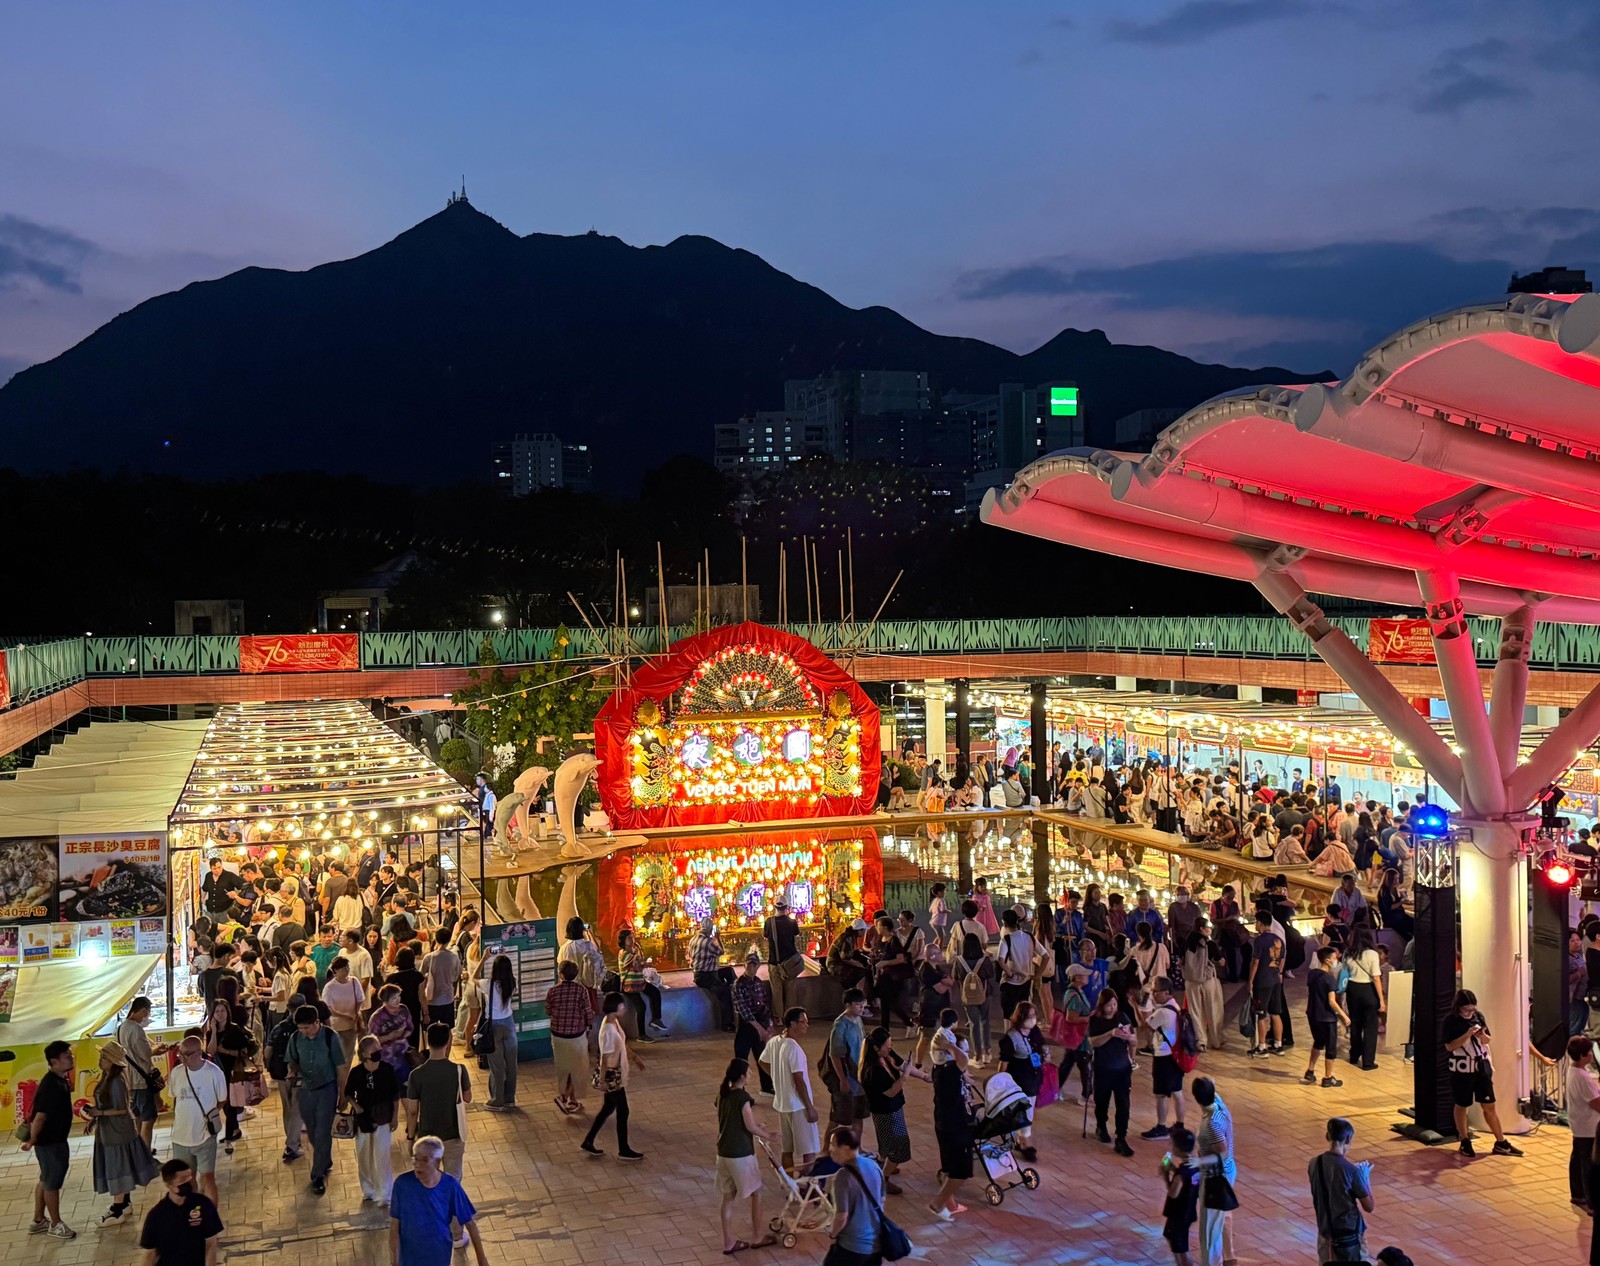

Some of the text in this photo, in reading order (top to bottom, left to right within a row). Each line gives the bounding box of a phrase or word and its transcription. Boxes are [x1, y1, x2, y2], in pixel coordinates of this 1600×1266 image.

[1384, 624, 1405, 653] 76
[261, 640, 288, 666] 76
[685, 781, 737, 798] VESPERE
[779, 776, 812, 792] MUN
[65, 839, 160, 854] 正宗長沙臭豆腐
